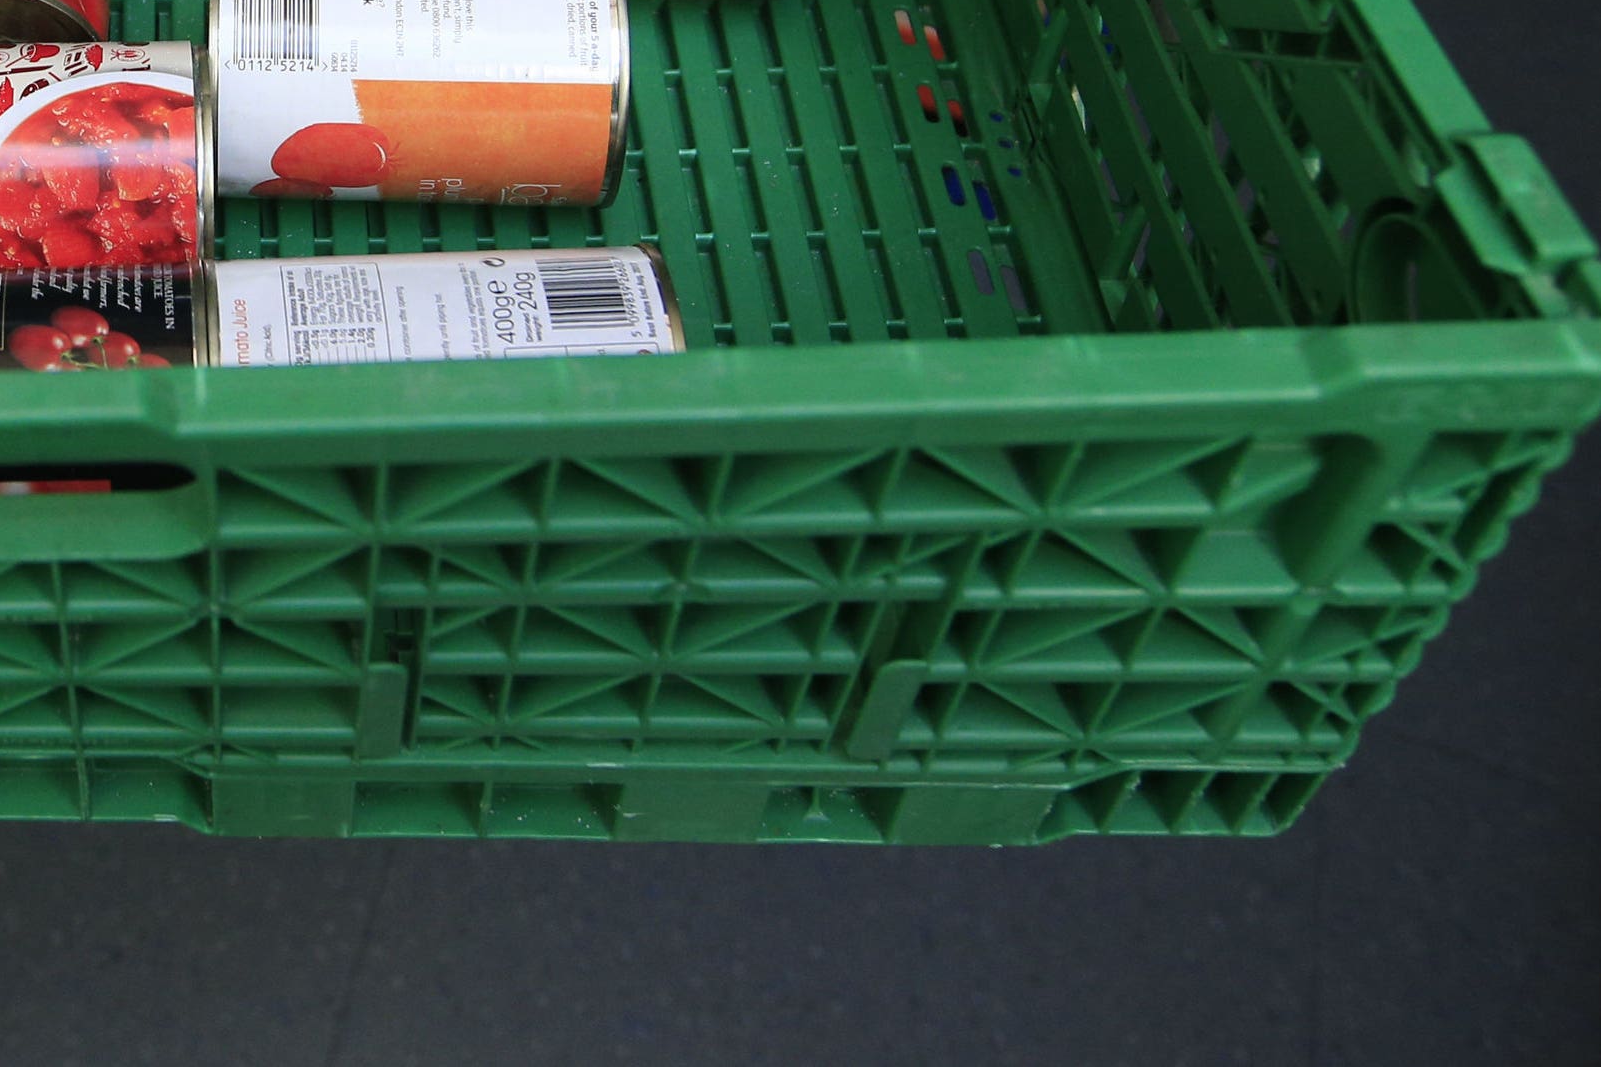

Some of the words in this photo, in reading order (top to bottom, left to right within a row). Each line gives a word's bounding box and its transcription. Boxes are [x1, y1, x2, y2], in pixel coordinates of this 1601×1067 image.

[589, 2, 598, 10] of
[588, 12, 598, 32] your
[238, 59, 272, 72] 0112
[281, 59, 314, 73] 5214
[513, 272, 538, 310] 240g
[166, 317, 175, 329] IN
[235, 299, 248, 331] Juice
